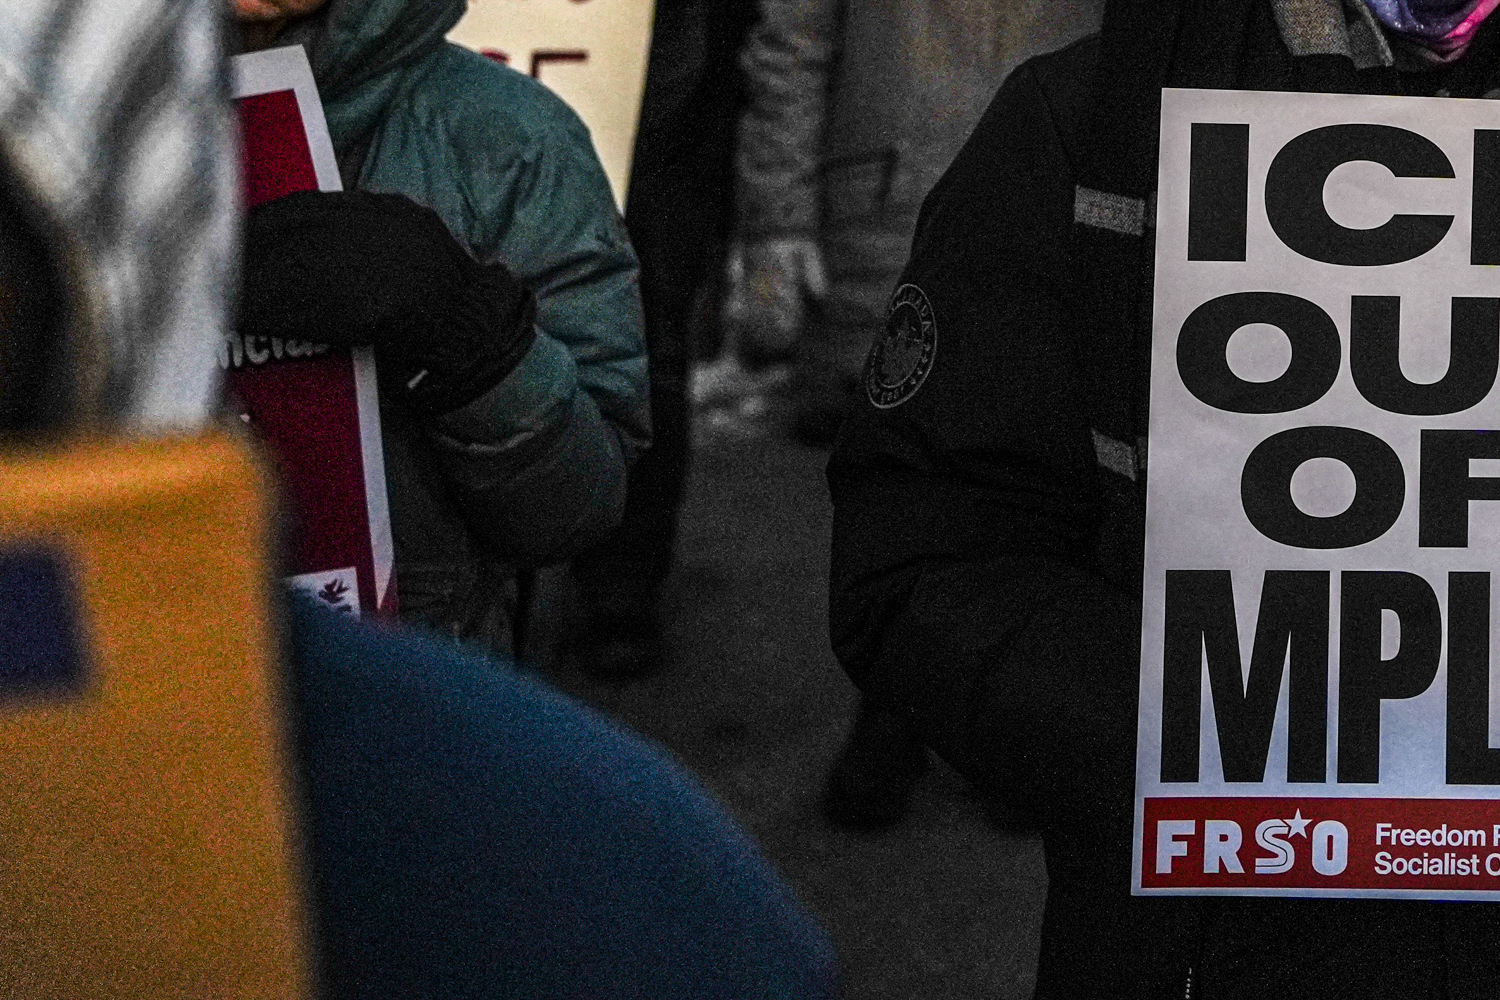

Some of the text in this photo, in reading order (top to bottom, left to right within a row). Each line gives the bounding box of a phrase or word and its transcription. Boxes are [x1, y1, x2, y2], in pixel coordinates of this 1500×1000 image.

[1155, 808, 1349, 876] FRSO
[1375, 822, 1488, 848] Freedom
[1374, 851, 1480, 877] Socialist
